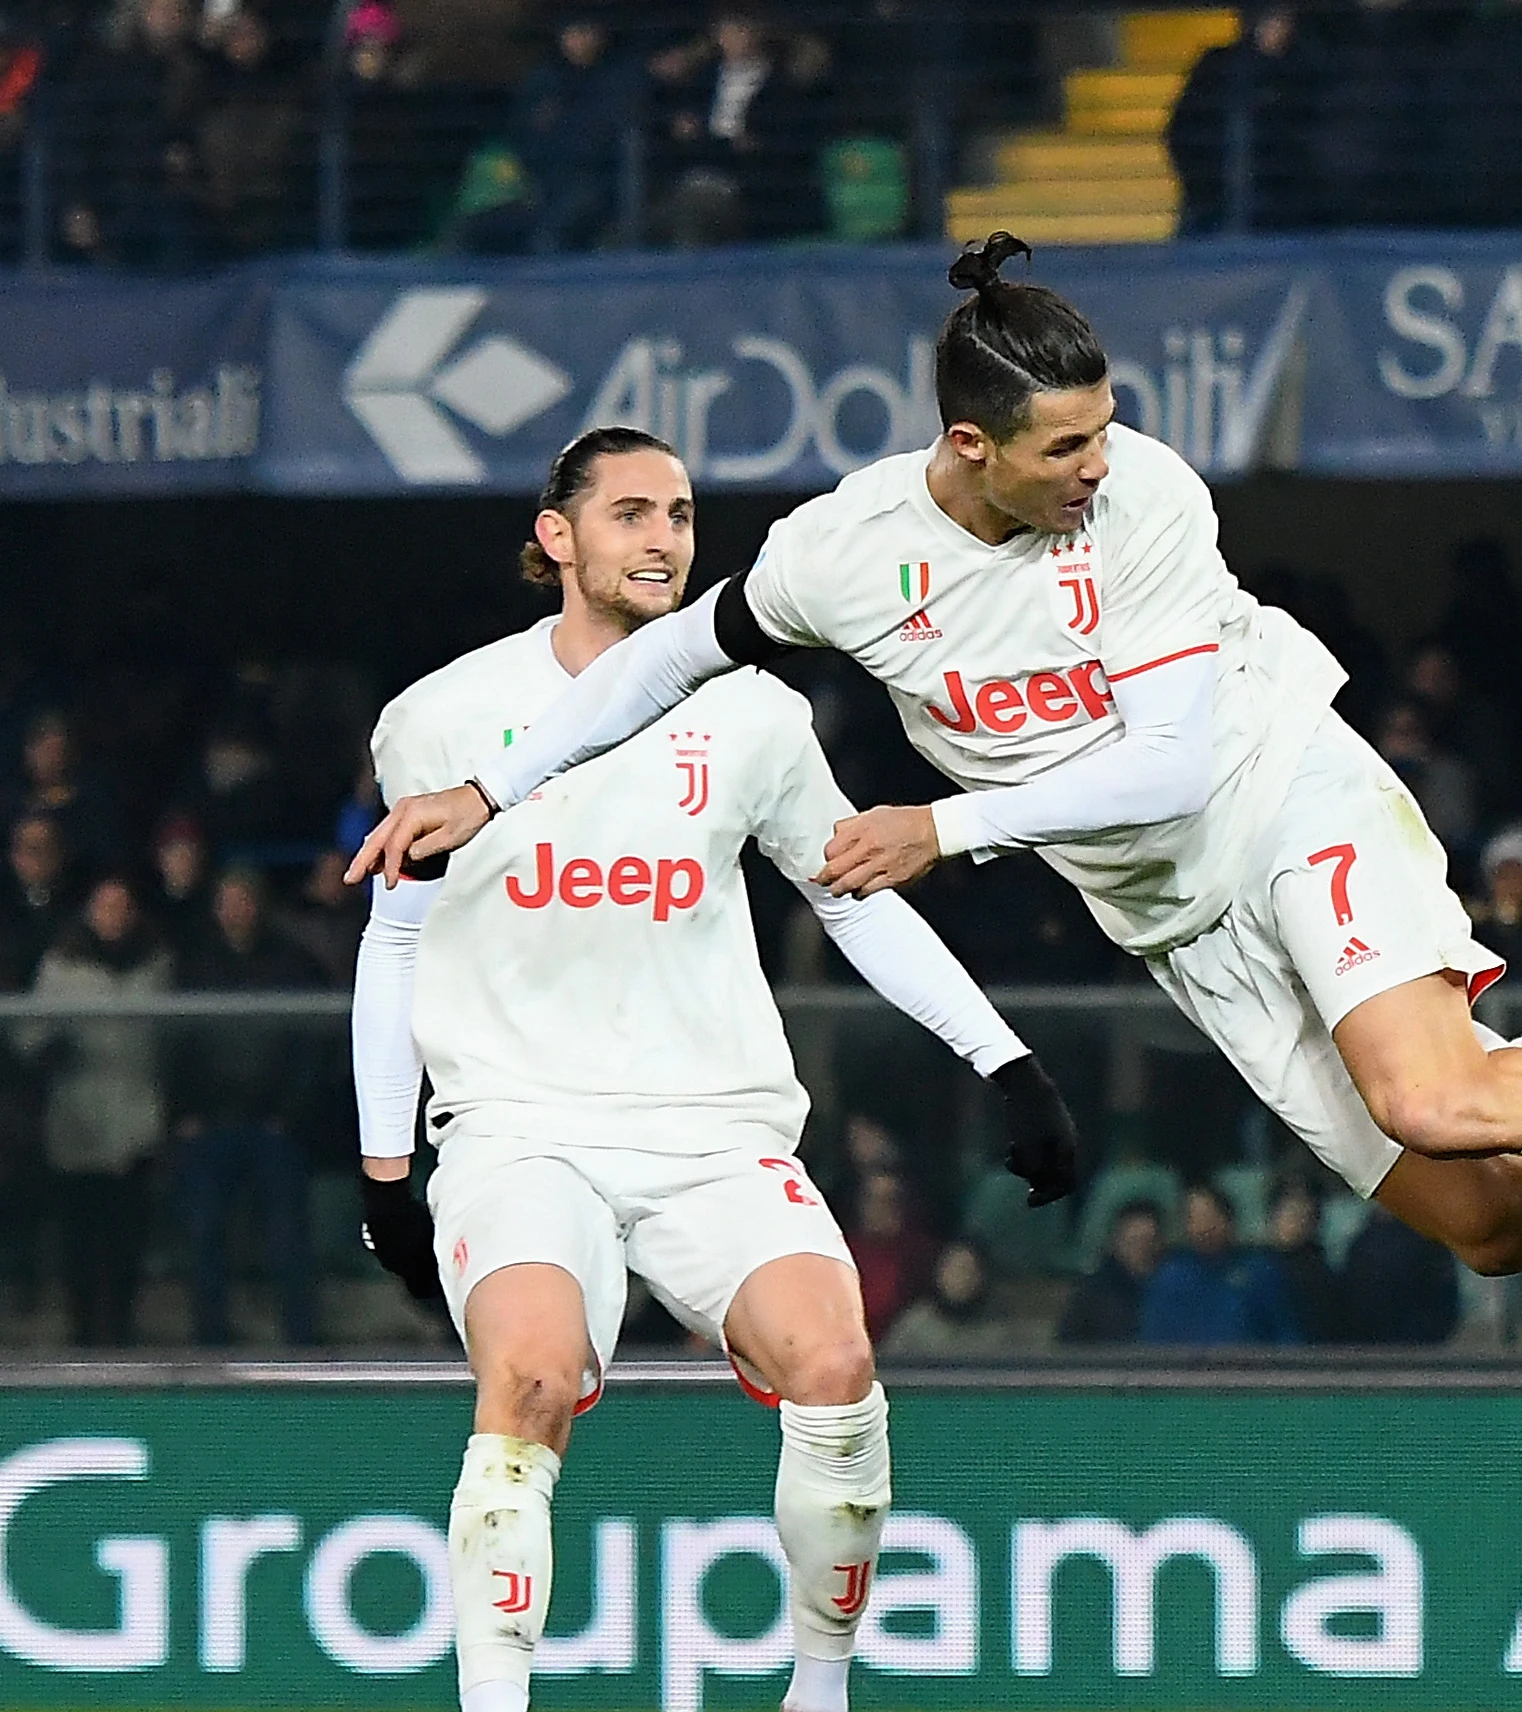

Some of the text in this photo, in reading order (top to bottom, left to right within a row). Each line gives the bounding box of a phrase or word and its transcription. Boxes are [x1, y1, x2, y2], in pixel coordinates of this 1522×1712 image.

[898, 627, 944, 642] adidas
[504, 841, 705, 922] Jeep
[1306, 842, 1357, 927] 7
[1334, 948, 1381, 977] adidas
